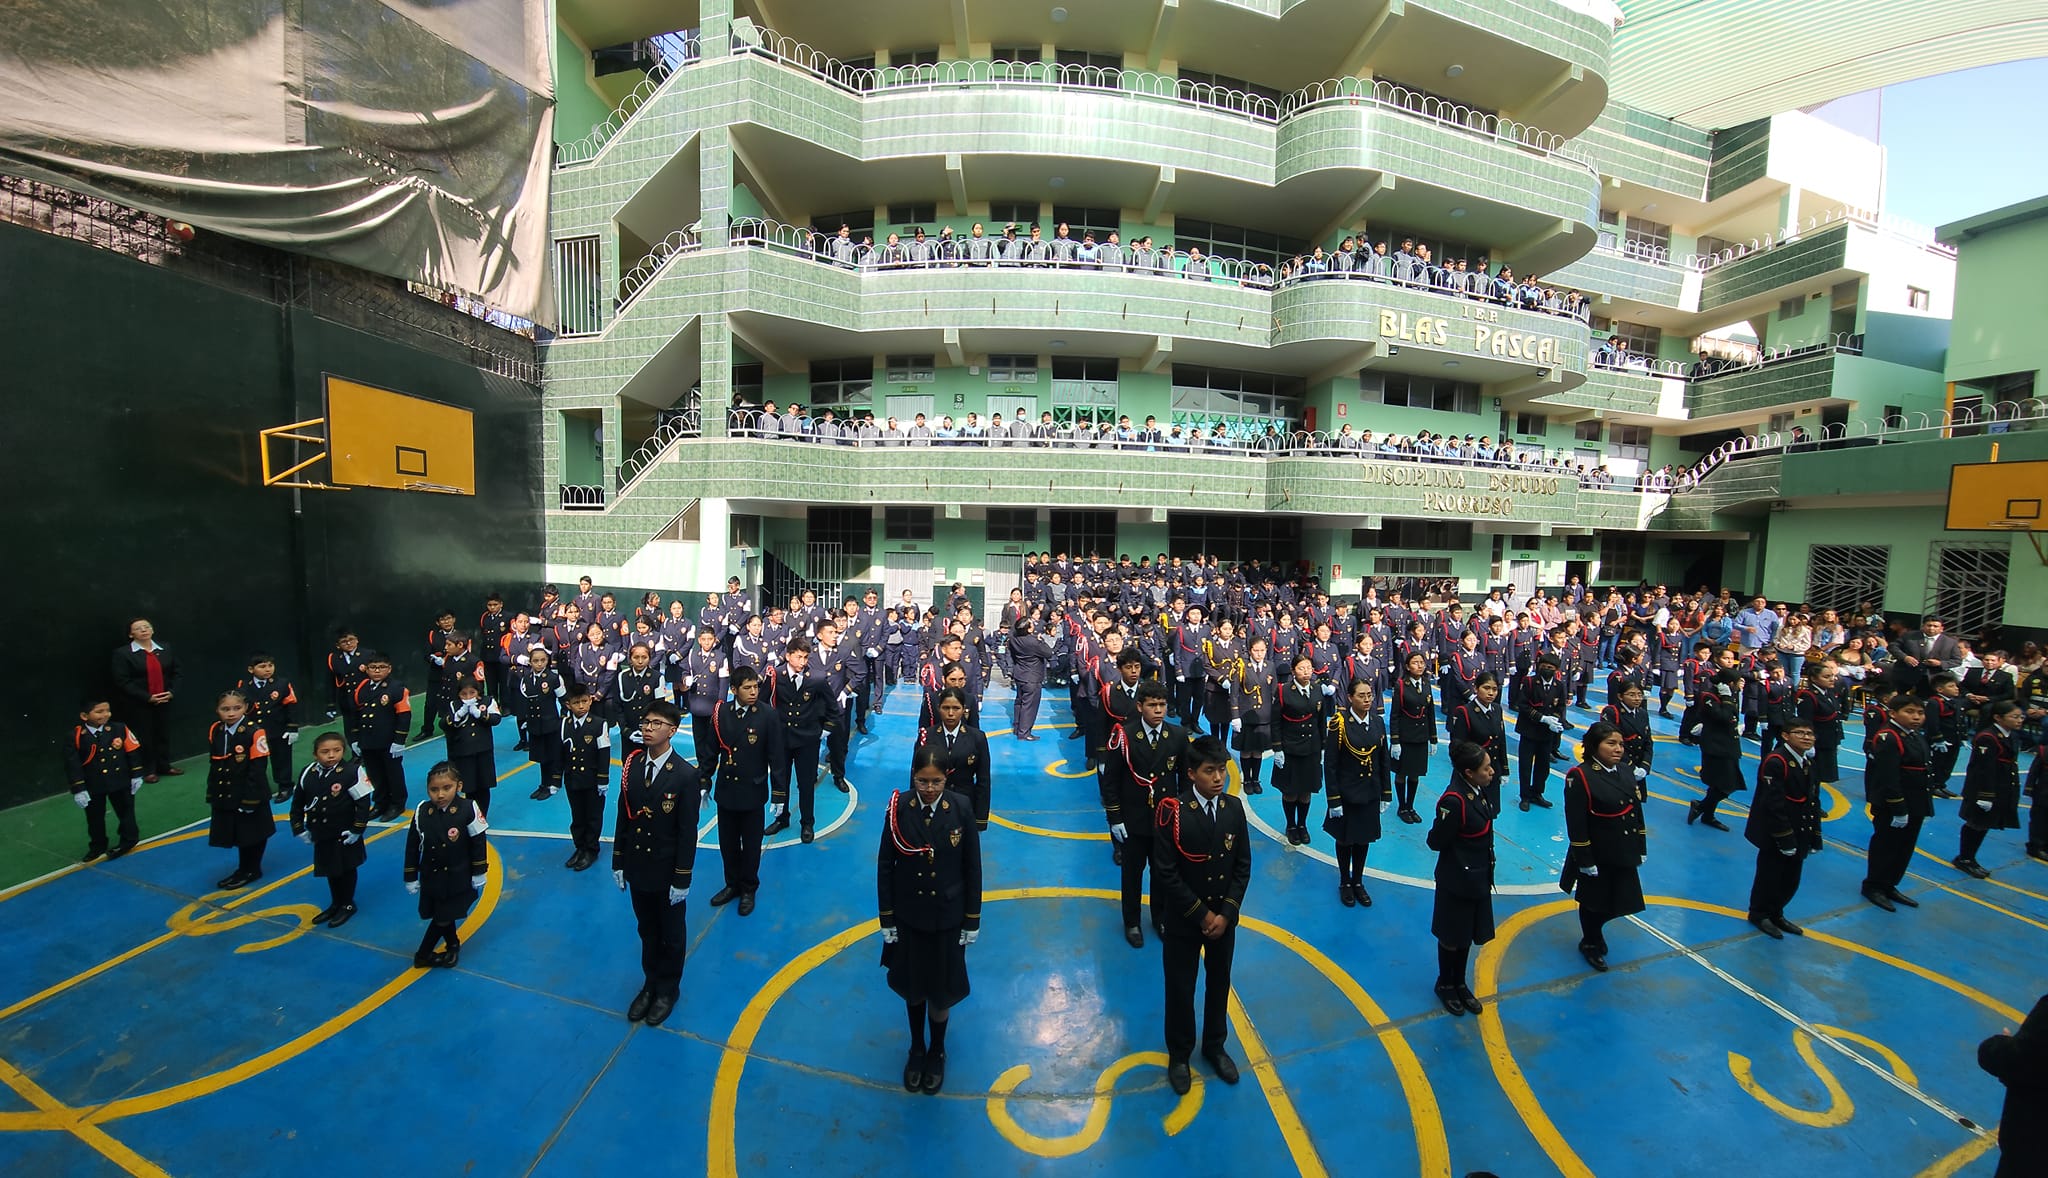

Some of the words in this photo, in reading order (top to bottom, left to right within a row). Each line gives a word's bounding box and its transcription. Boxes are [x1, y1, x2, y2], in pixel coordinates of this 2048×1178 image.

[1380, 309, 1449, 345] BLAS
[1474, 324, 1564, 364] PASCAL
[1362, 463, 1466, 490] DISCIPLINA
[1489, 473, 1560, 496] ESTUDIO
[1423, 491, 1513, 516] PROGRESO
